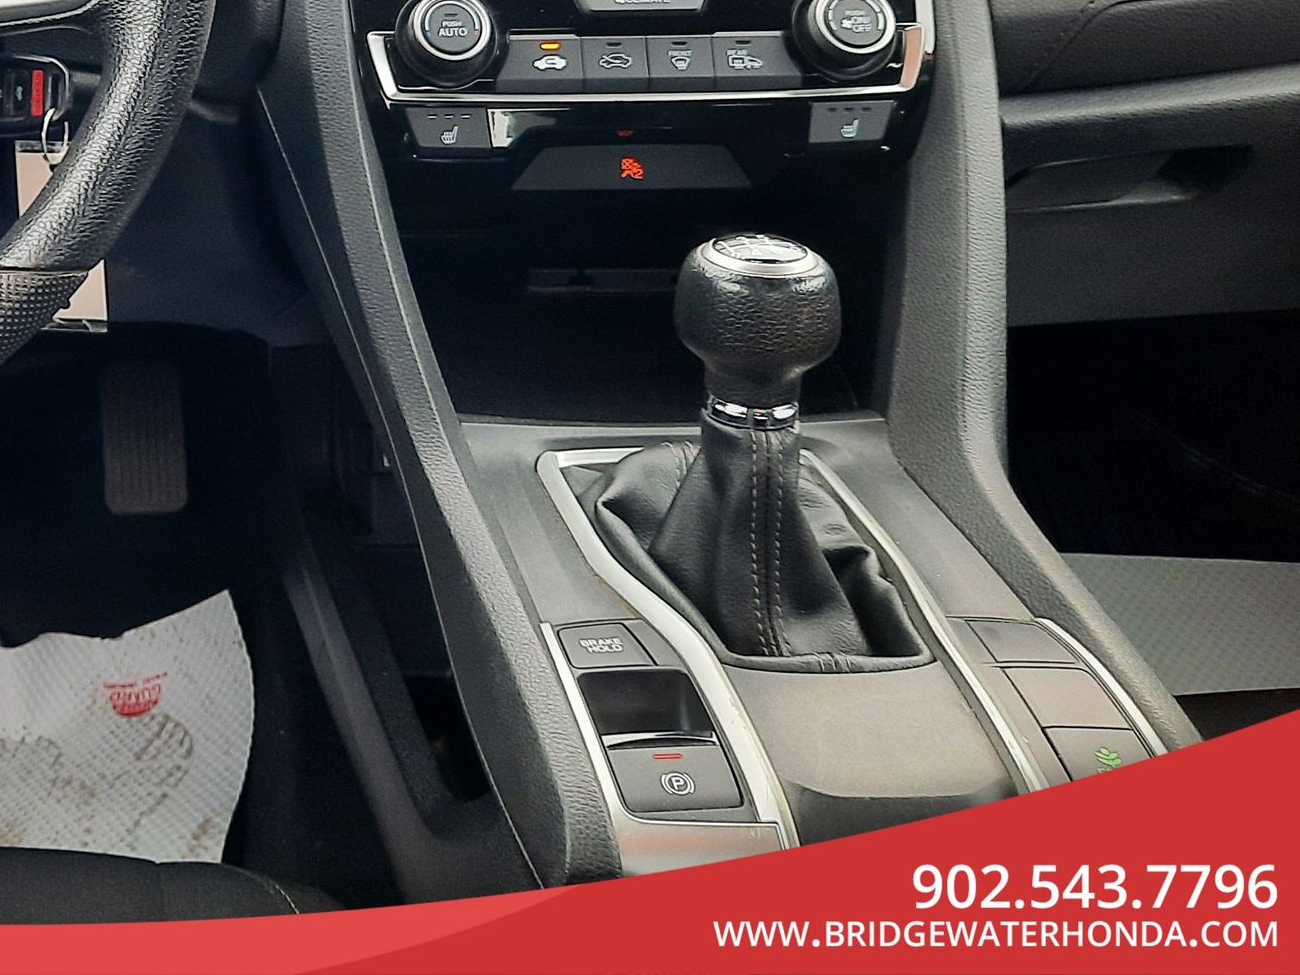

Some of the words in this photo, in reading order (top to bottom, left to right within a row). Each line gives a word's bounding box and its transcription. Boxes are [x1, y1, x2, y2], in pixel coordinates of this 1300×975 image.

[438, 27, 467, 37] AUTO
[580, 637, 623, 648] BRAKE
[587, 644, 623, 653] HOLD
